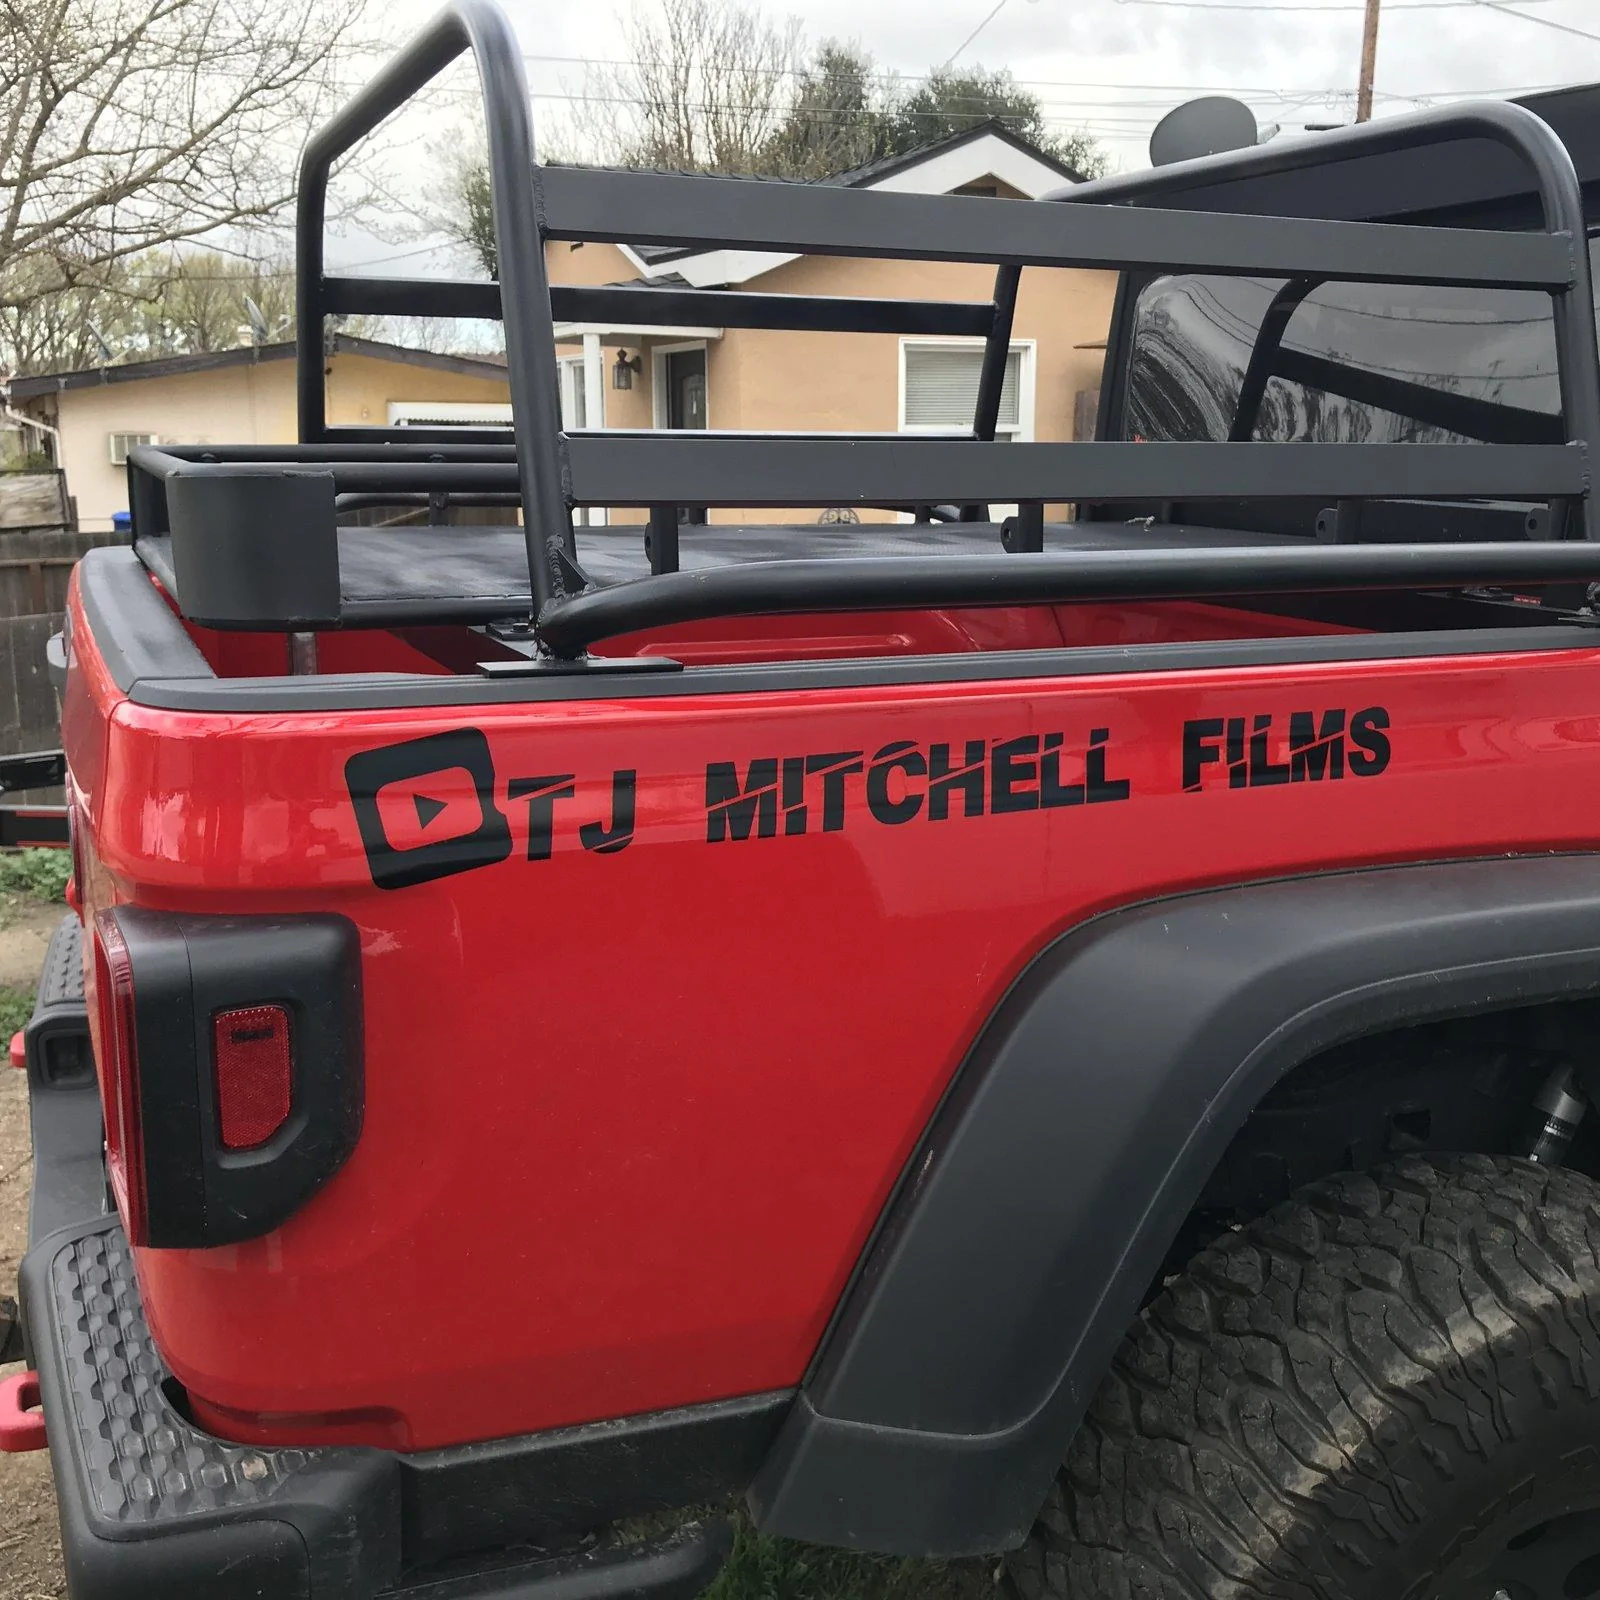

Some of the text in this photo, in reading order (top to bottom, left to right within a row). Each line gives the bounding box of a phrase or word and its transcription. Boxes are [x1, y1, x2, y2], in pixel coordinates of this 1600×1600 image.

[507, 706, 1391, 861] TJ MITCHELL FILMS
